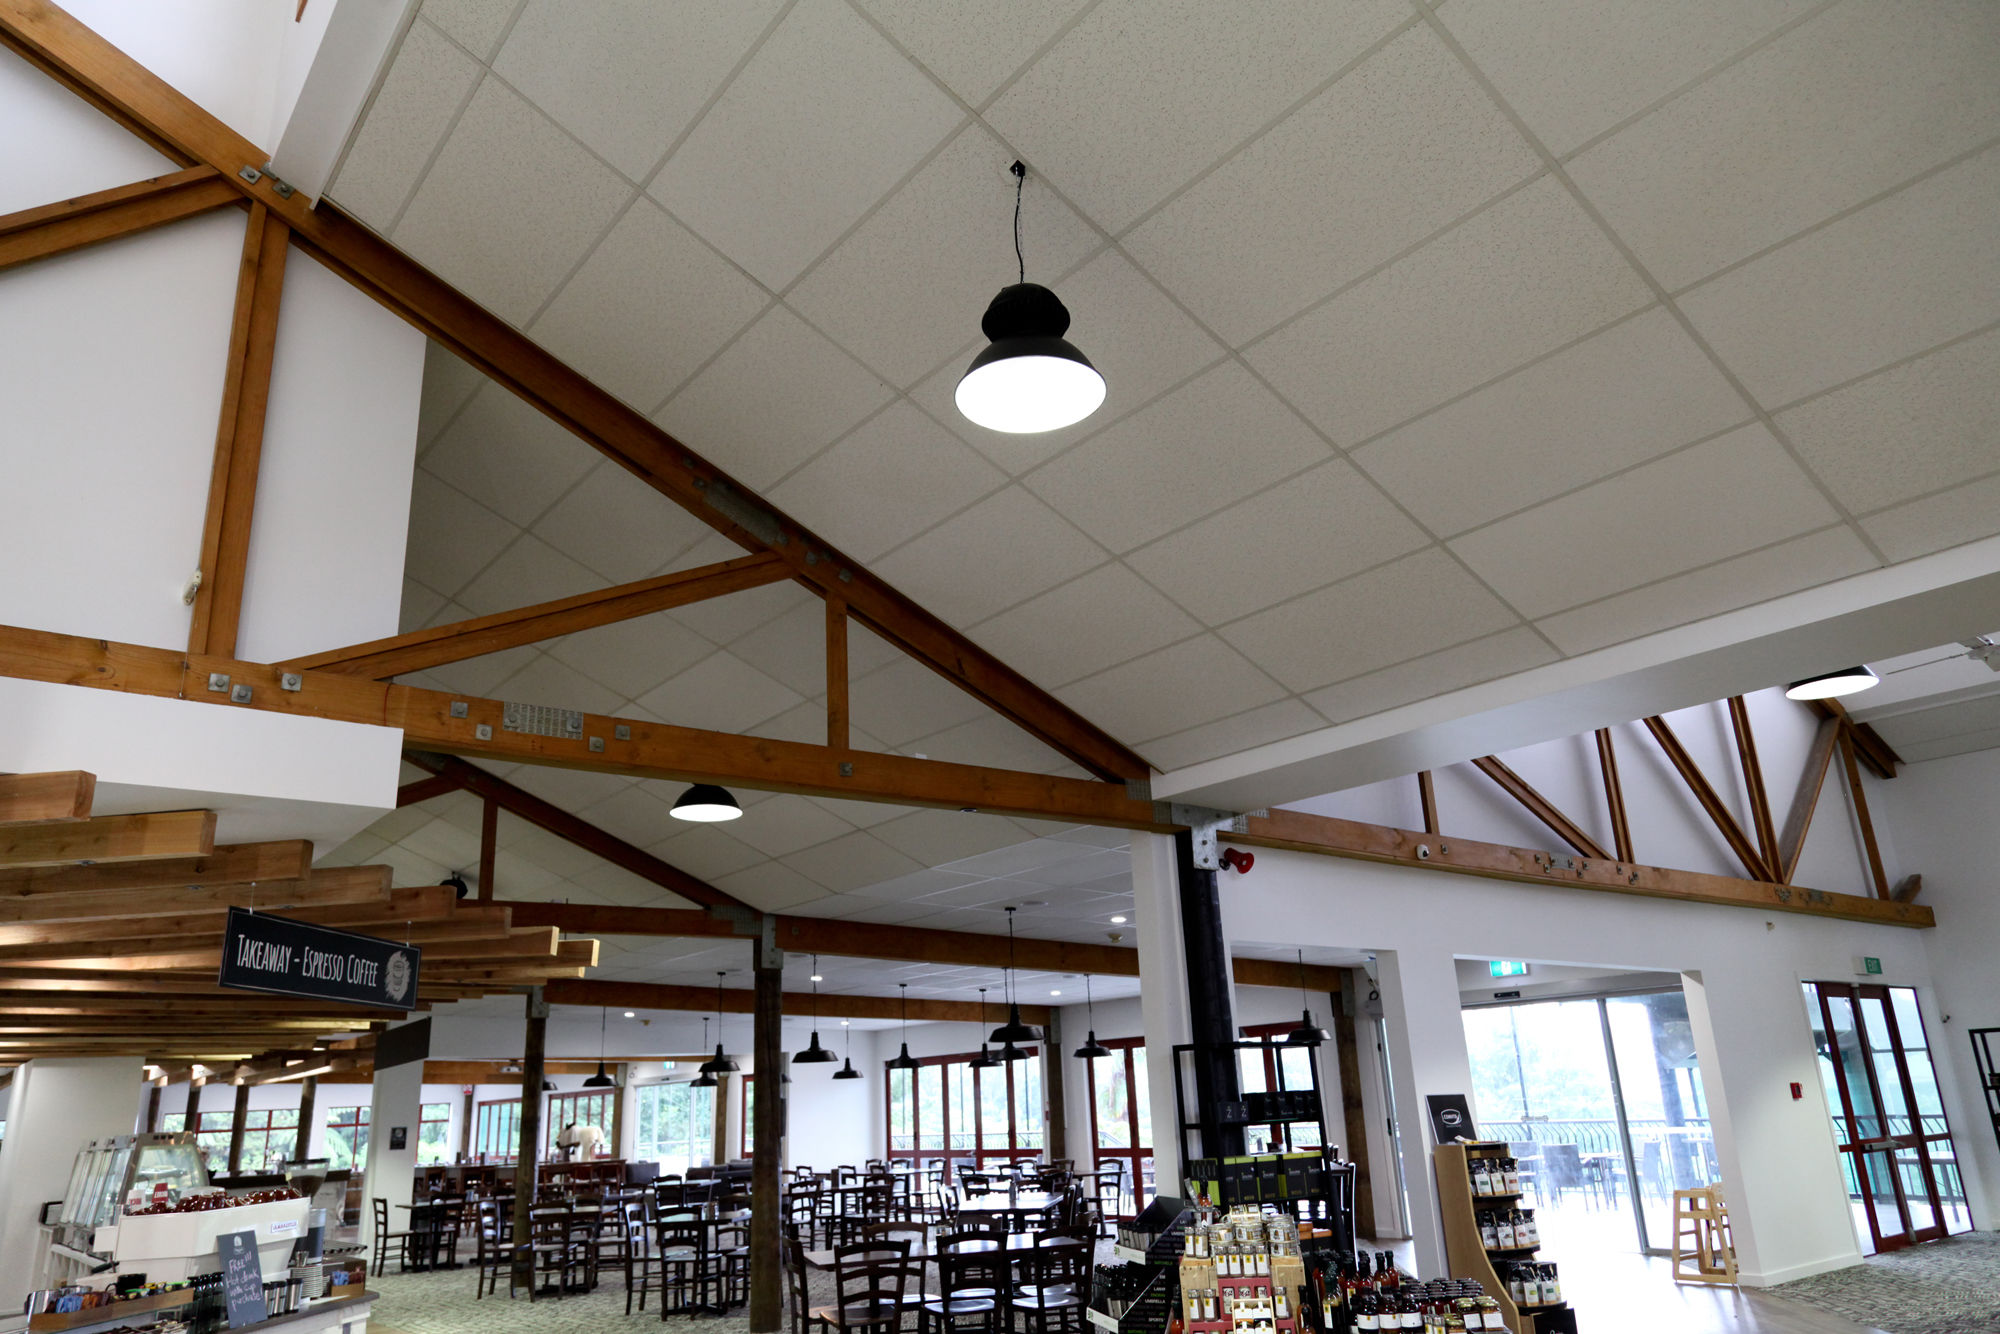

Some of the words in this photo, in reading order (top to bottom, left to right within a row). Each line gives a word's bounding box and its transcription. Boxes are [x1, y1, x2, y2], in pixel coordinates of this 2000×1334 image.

[236, 934, 292, 974] TAKEAWAY
[302, 946, 344, 982] ESPRESSO
[347, 954, 379, 987] COFFEE
[1867, 959, 1878, 972] EXIT
